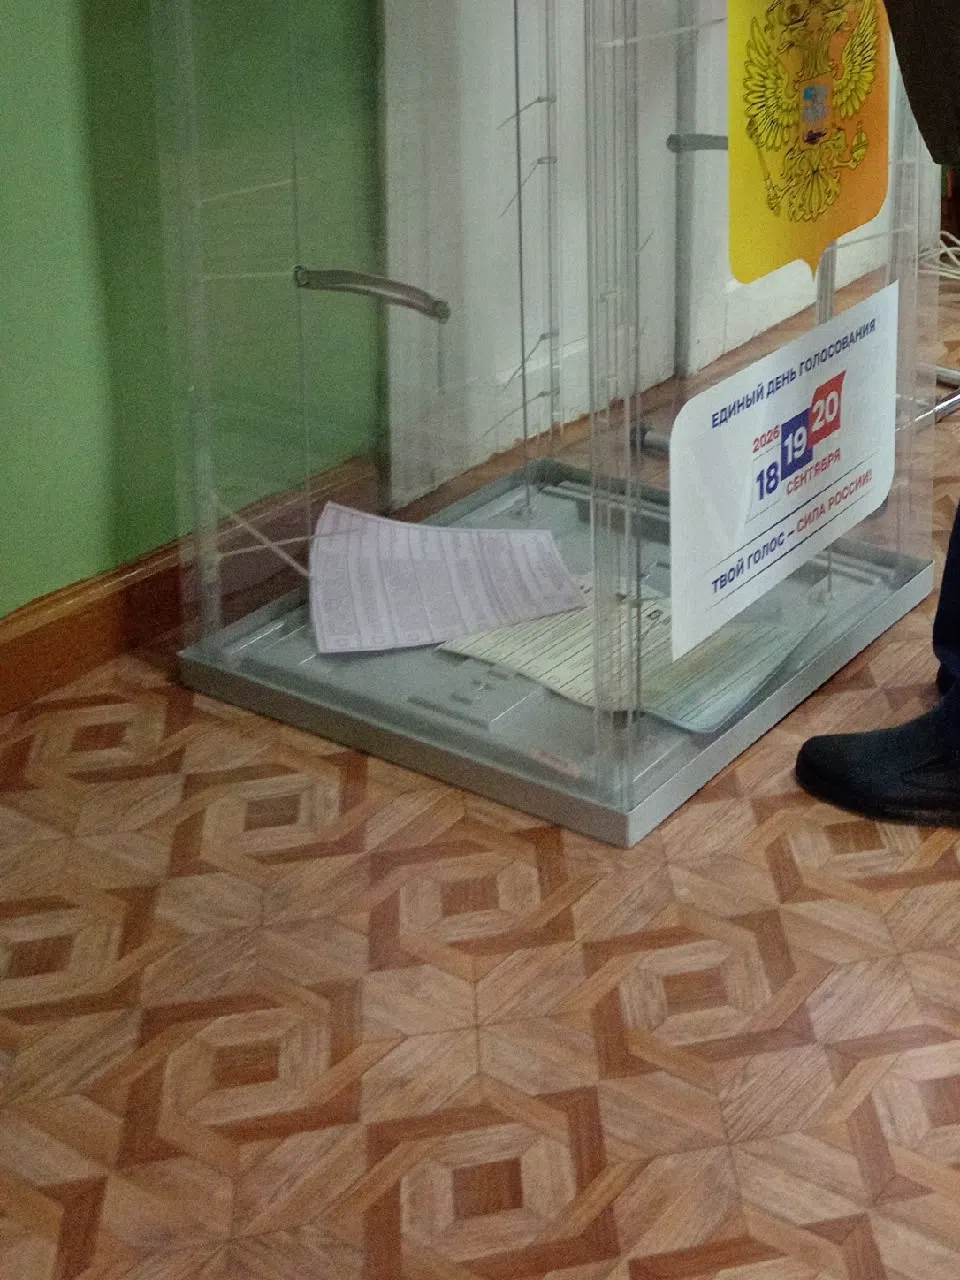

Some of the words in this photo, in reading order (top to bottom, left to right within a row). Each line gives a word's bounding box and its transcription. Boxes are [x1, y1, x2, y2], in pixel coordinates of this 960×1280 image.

[711, 383, 765, 429] ЕДИНЫЙ
[766, 369, 797, 402] ДЕНЬ
[799, 318, 877, 377] ГОЛОСОВАНИЯ
[752, 424, 780, 453] 2026
[755, 462, 779, 501] 18
[783, 427, 807, 465] 19
[811, 389, 840, 432] 20
[786, 448, 841, 496] СЕНТЯБРЯ
[711, 559, 744, 594] ТВОЙ
[746, 531, 785, 570] ГОЛОС
[796, 504, 826, 533] СИЛА
[827, 469, 873, 514] РОССИИ!
